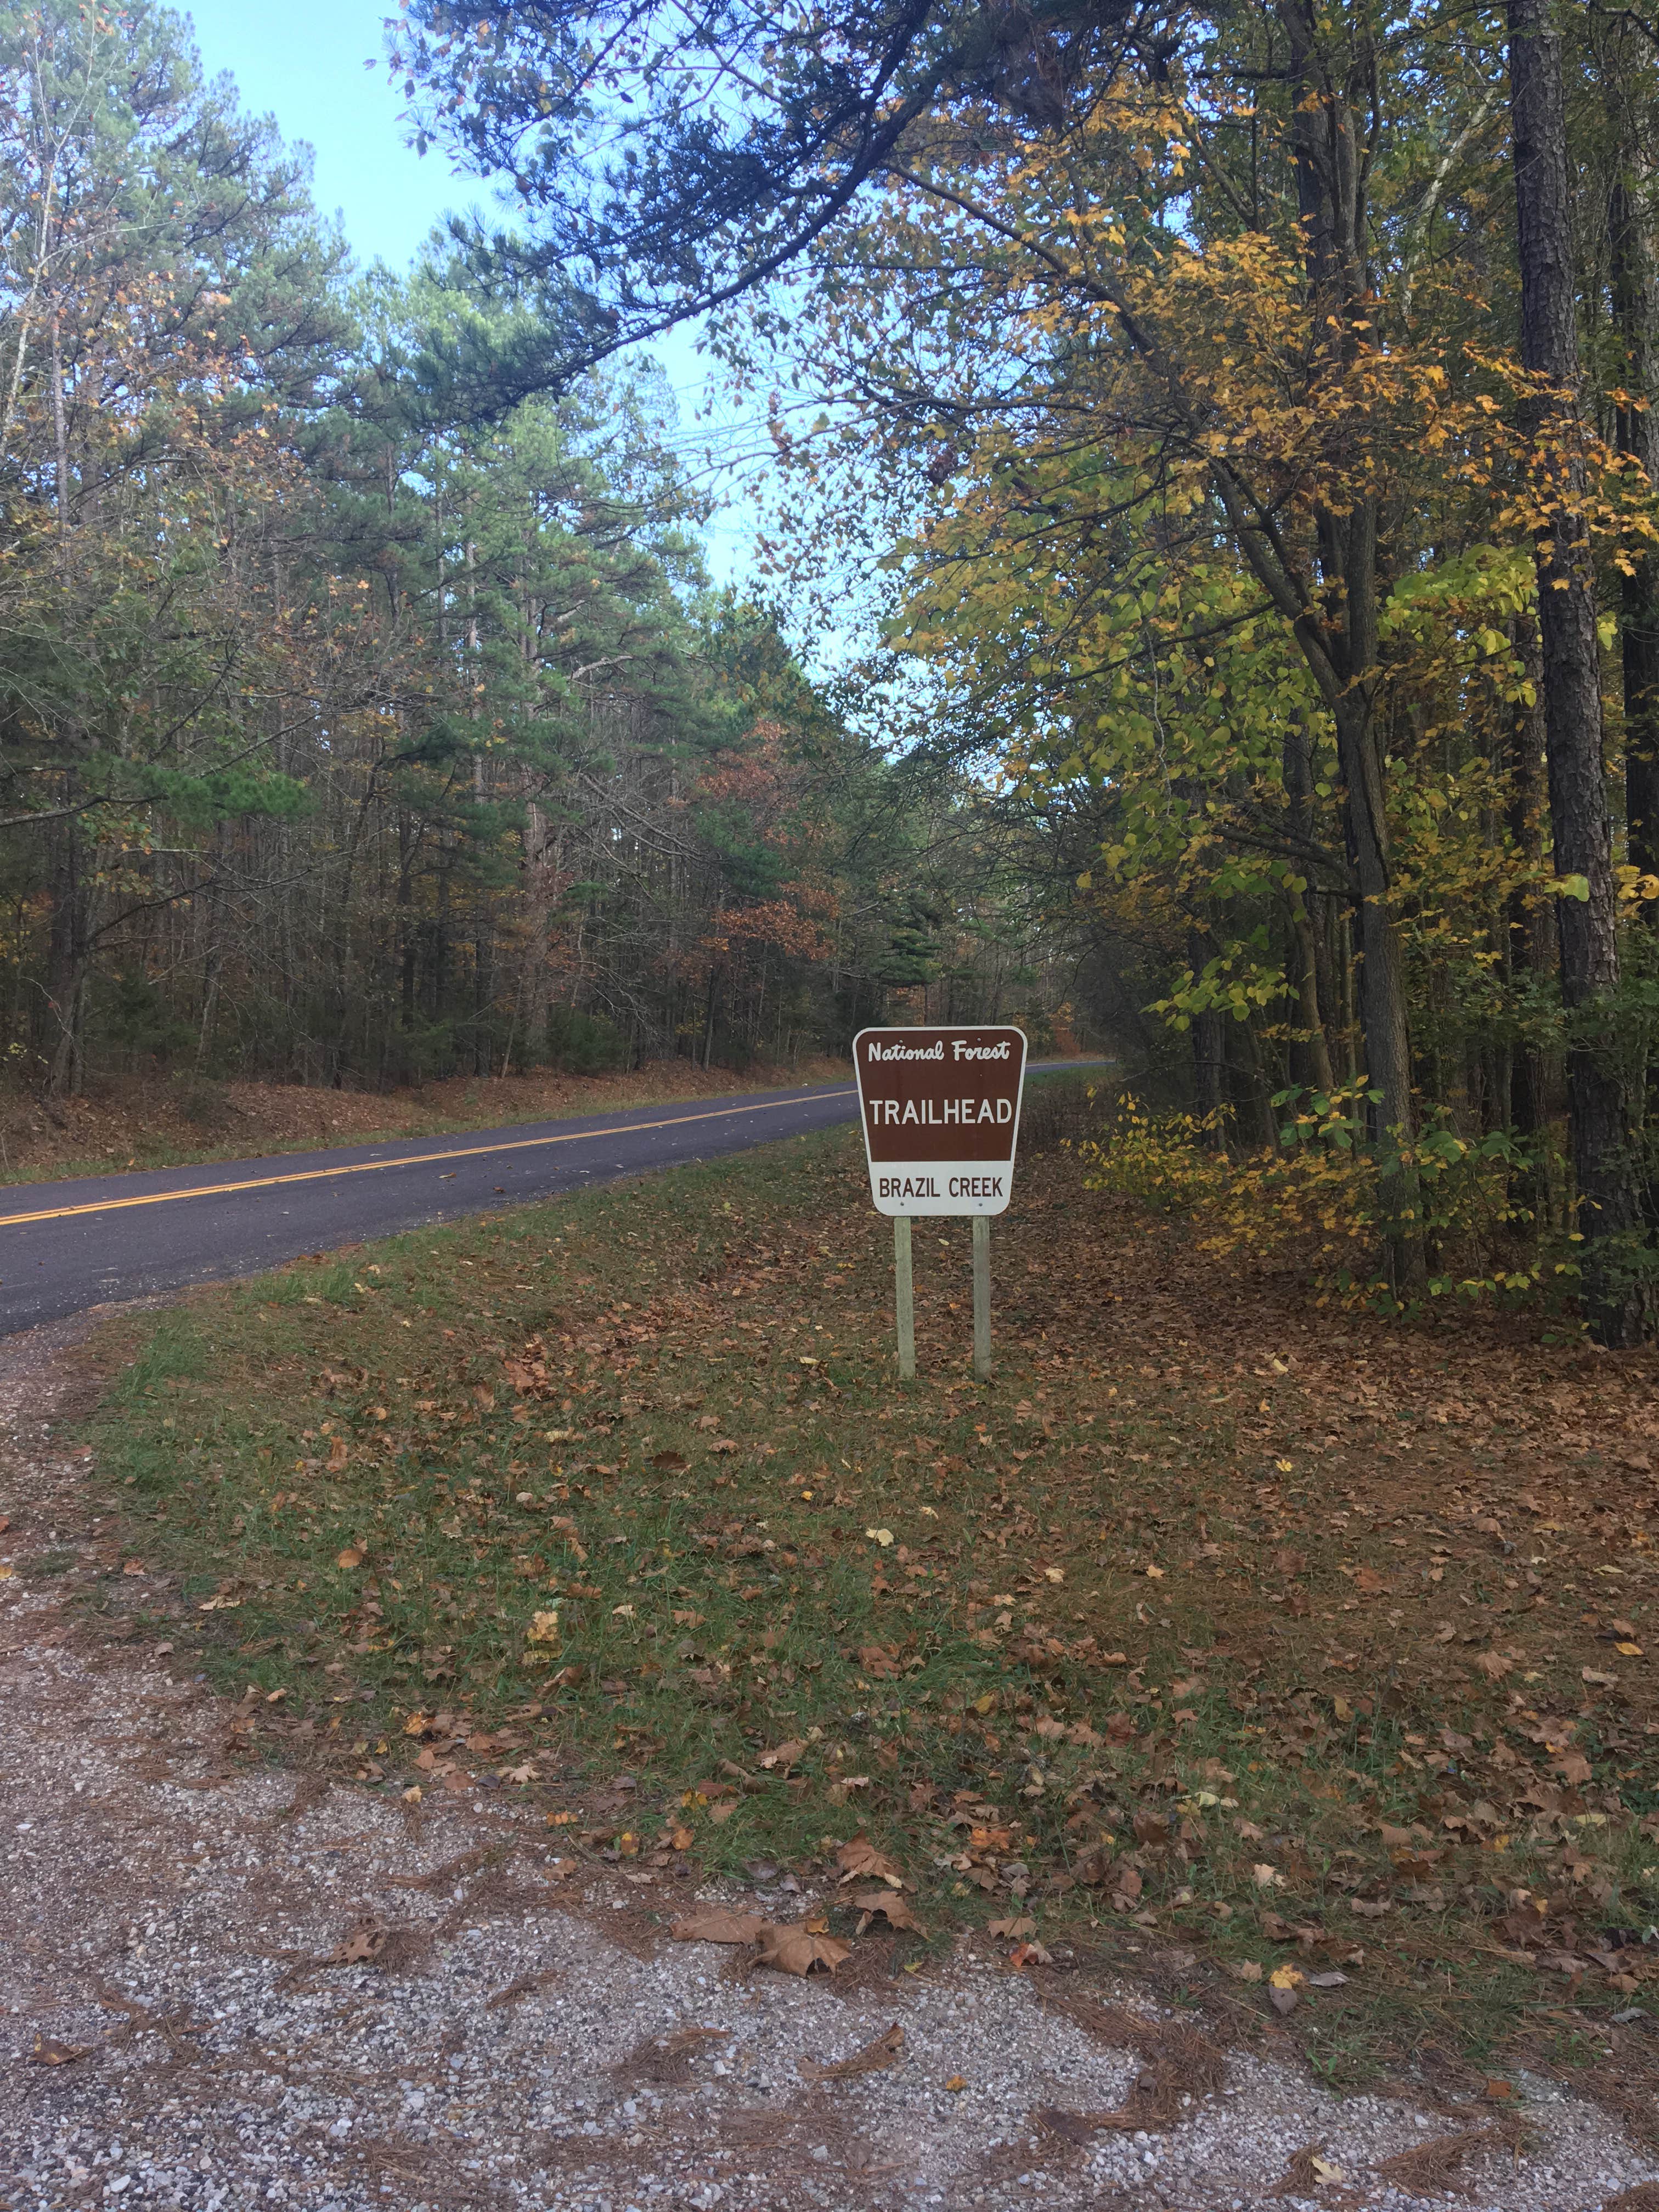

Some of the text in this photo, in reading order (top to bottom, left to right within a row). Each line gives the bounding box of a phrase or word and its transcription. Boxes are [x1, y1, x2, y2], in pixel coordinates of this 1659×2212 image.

[868, 1040, 1011, 1062] National Forest
[869, 1099, 1012, 1125] TRAILHEAD
[879, 1177, 1003, 1198] BRAZIL CREEK
